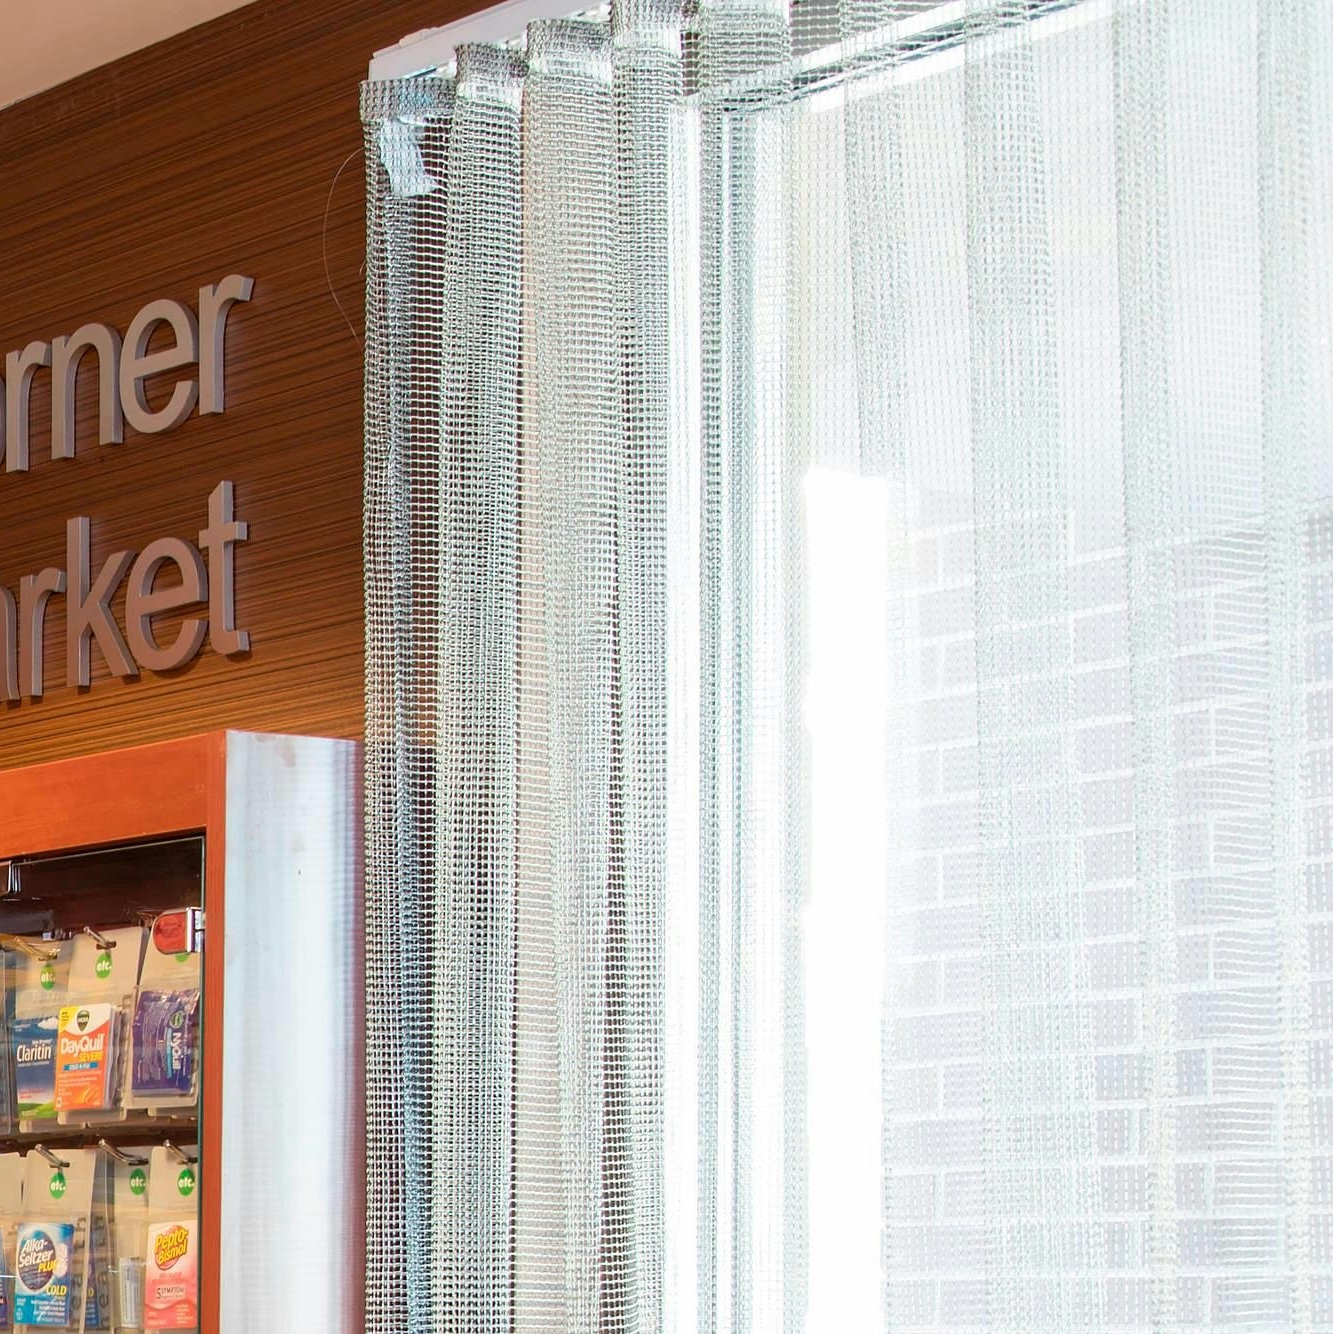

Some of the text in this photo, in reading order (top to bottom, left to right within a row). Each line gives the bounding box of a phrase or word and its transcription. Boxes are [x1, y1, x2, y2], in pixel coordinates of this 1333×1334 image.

[17, 1044, 52, 1061] Claritin
[61, 1034, 103, 1057] DayQuil
[79, 1052, 103, 1061] SEVERE
[22, 1238, 48, 1252] Alka-
[155, 1228, 188, 1250] Pepto-
[18, 1250, 55, 1266] Seltzer
[156, 1243, 187, 1265] Bismol
[46, 1285, 67, 1296] COLD
